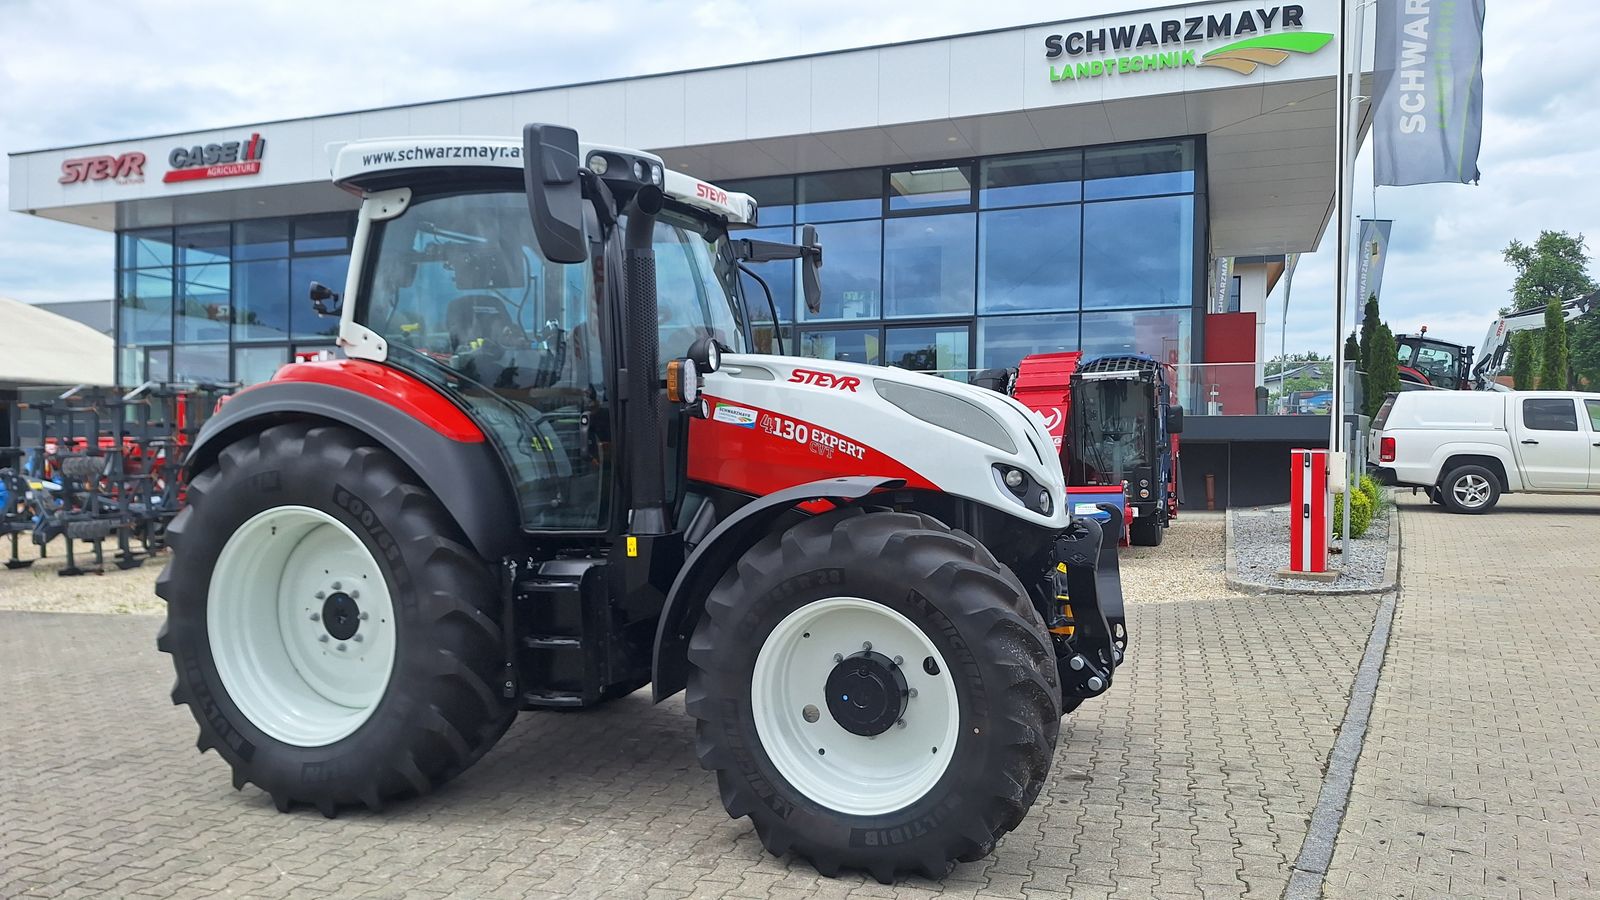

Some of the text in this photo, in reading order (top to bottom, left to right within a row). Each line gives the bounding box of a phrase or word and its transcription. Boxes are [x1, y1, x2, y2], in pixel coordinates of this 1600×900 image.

[1045, 4, 1304, 59] SCHWARZMAYR
[1049, 49, 1196, 82] LANDTECHNIK
[59, 151, 146, 184] STEYR
[168, 141, 240, 169] CASE
[206, 162, 257, 177] AGRICULTURE
[696, 183, 728, 206] STEYR
[787, 368, 861, 393] STEYR
[760, 414, 865, 460] 4130 EXPERT
[809, 440, 835, 459] CVT
